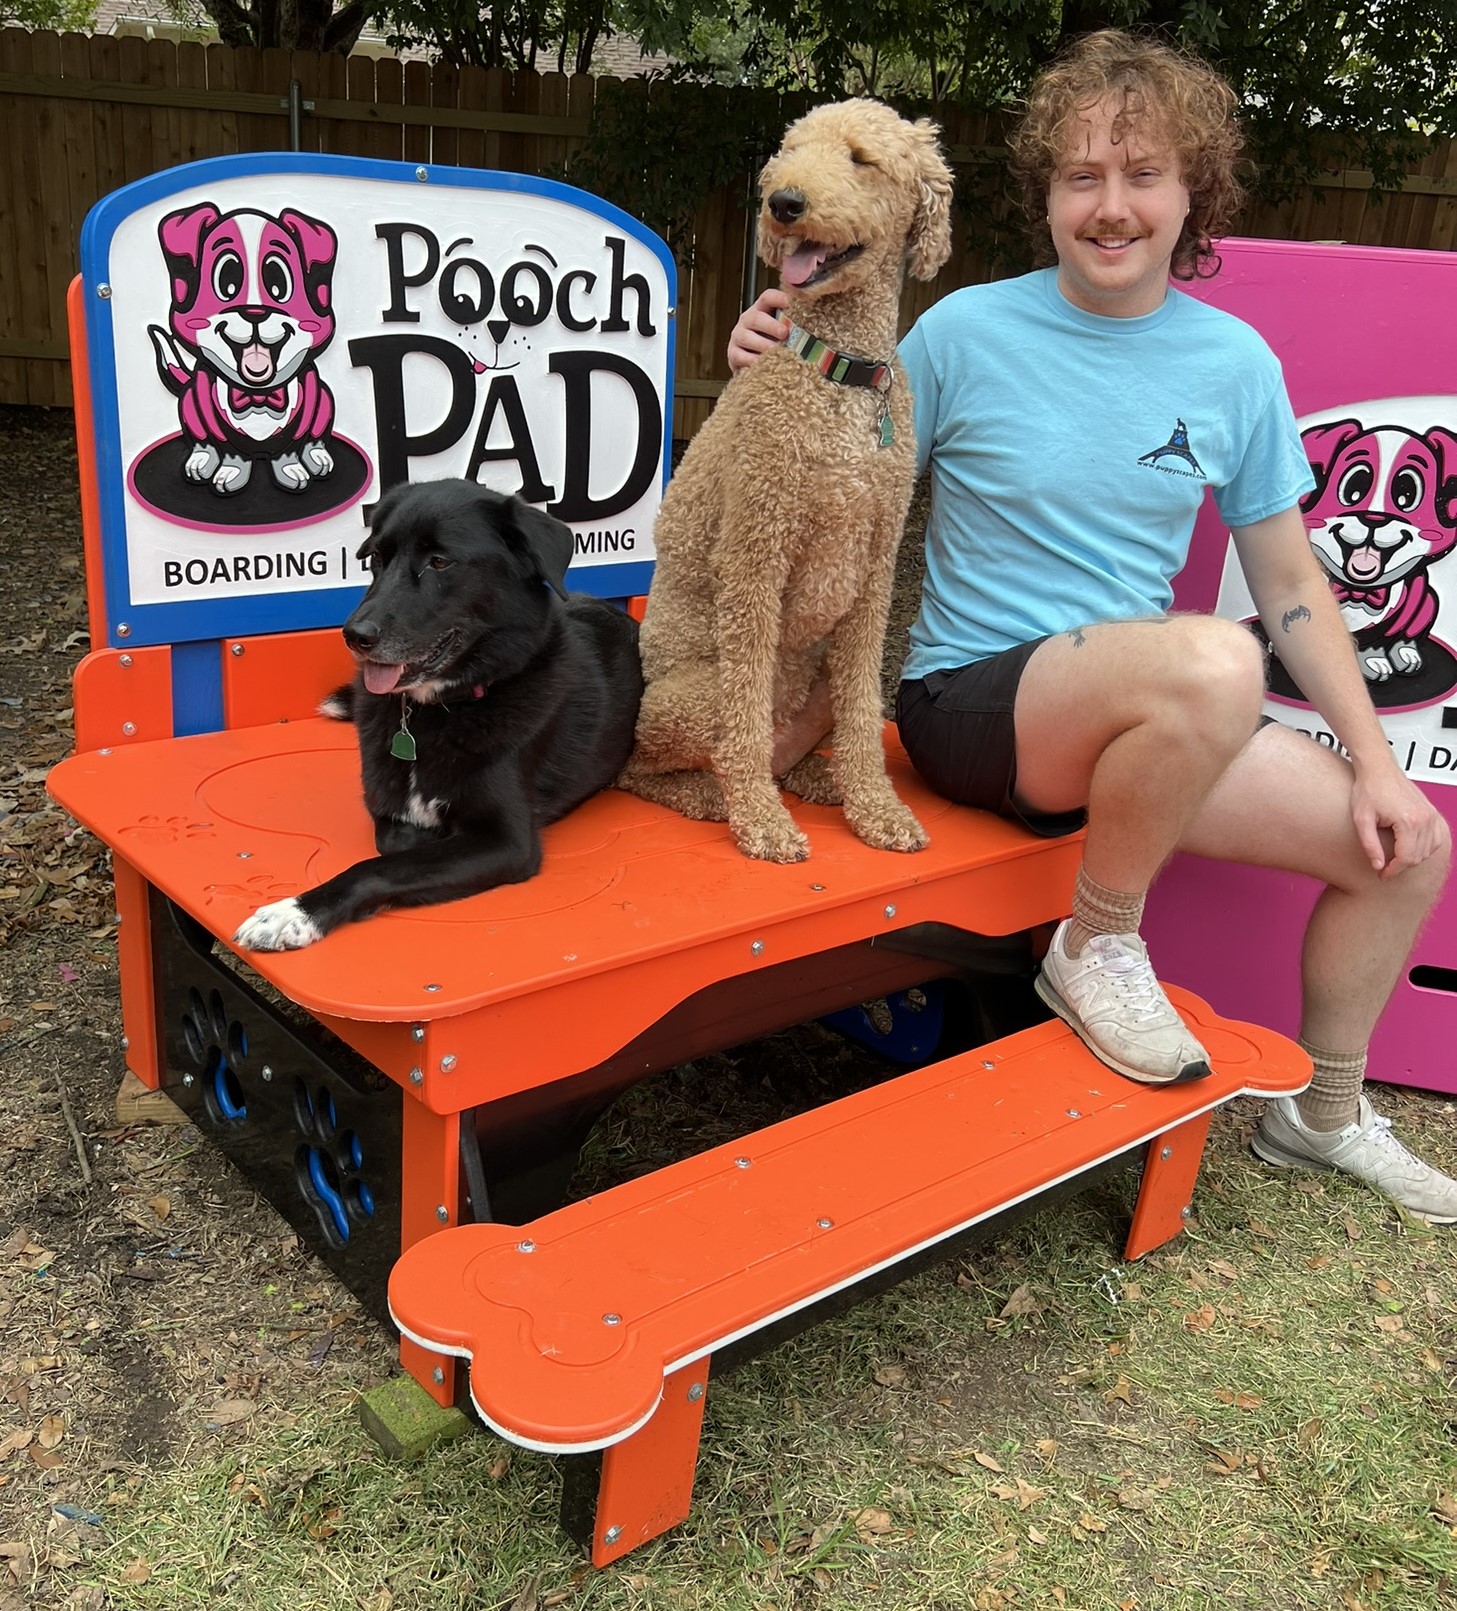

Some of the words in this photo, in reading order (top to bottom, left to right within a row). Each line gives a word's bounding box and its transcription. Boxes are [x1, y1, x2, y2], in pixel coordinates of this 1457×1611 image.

[375, 222, 657, 337] Pooch
[347, 333, 662, 528] PAD
[164, 551, 327, 587] BOARDING
[574, 528, 635, 555] MING
